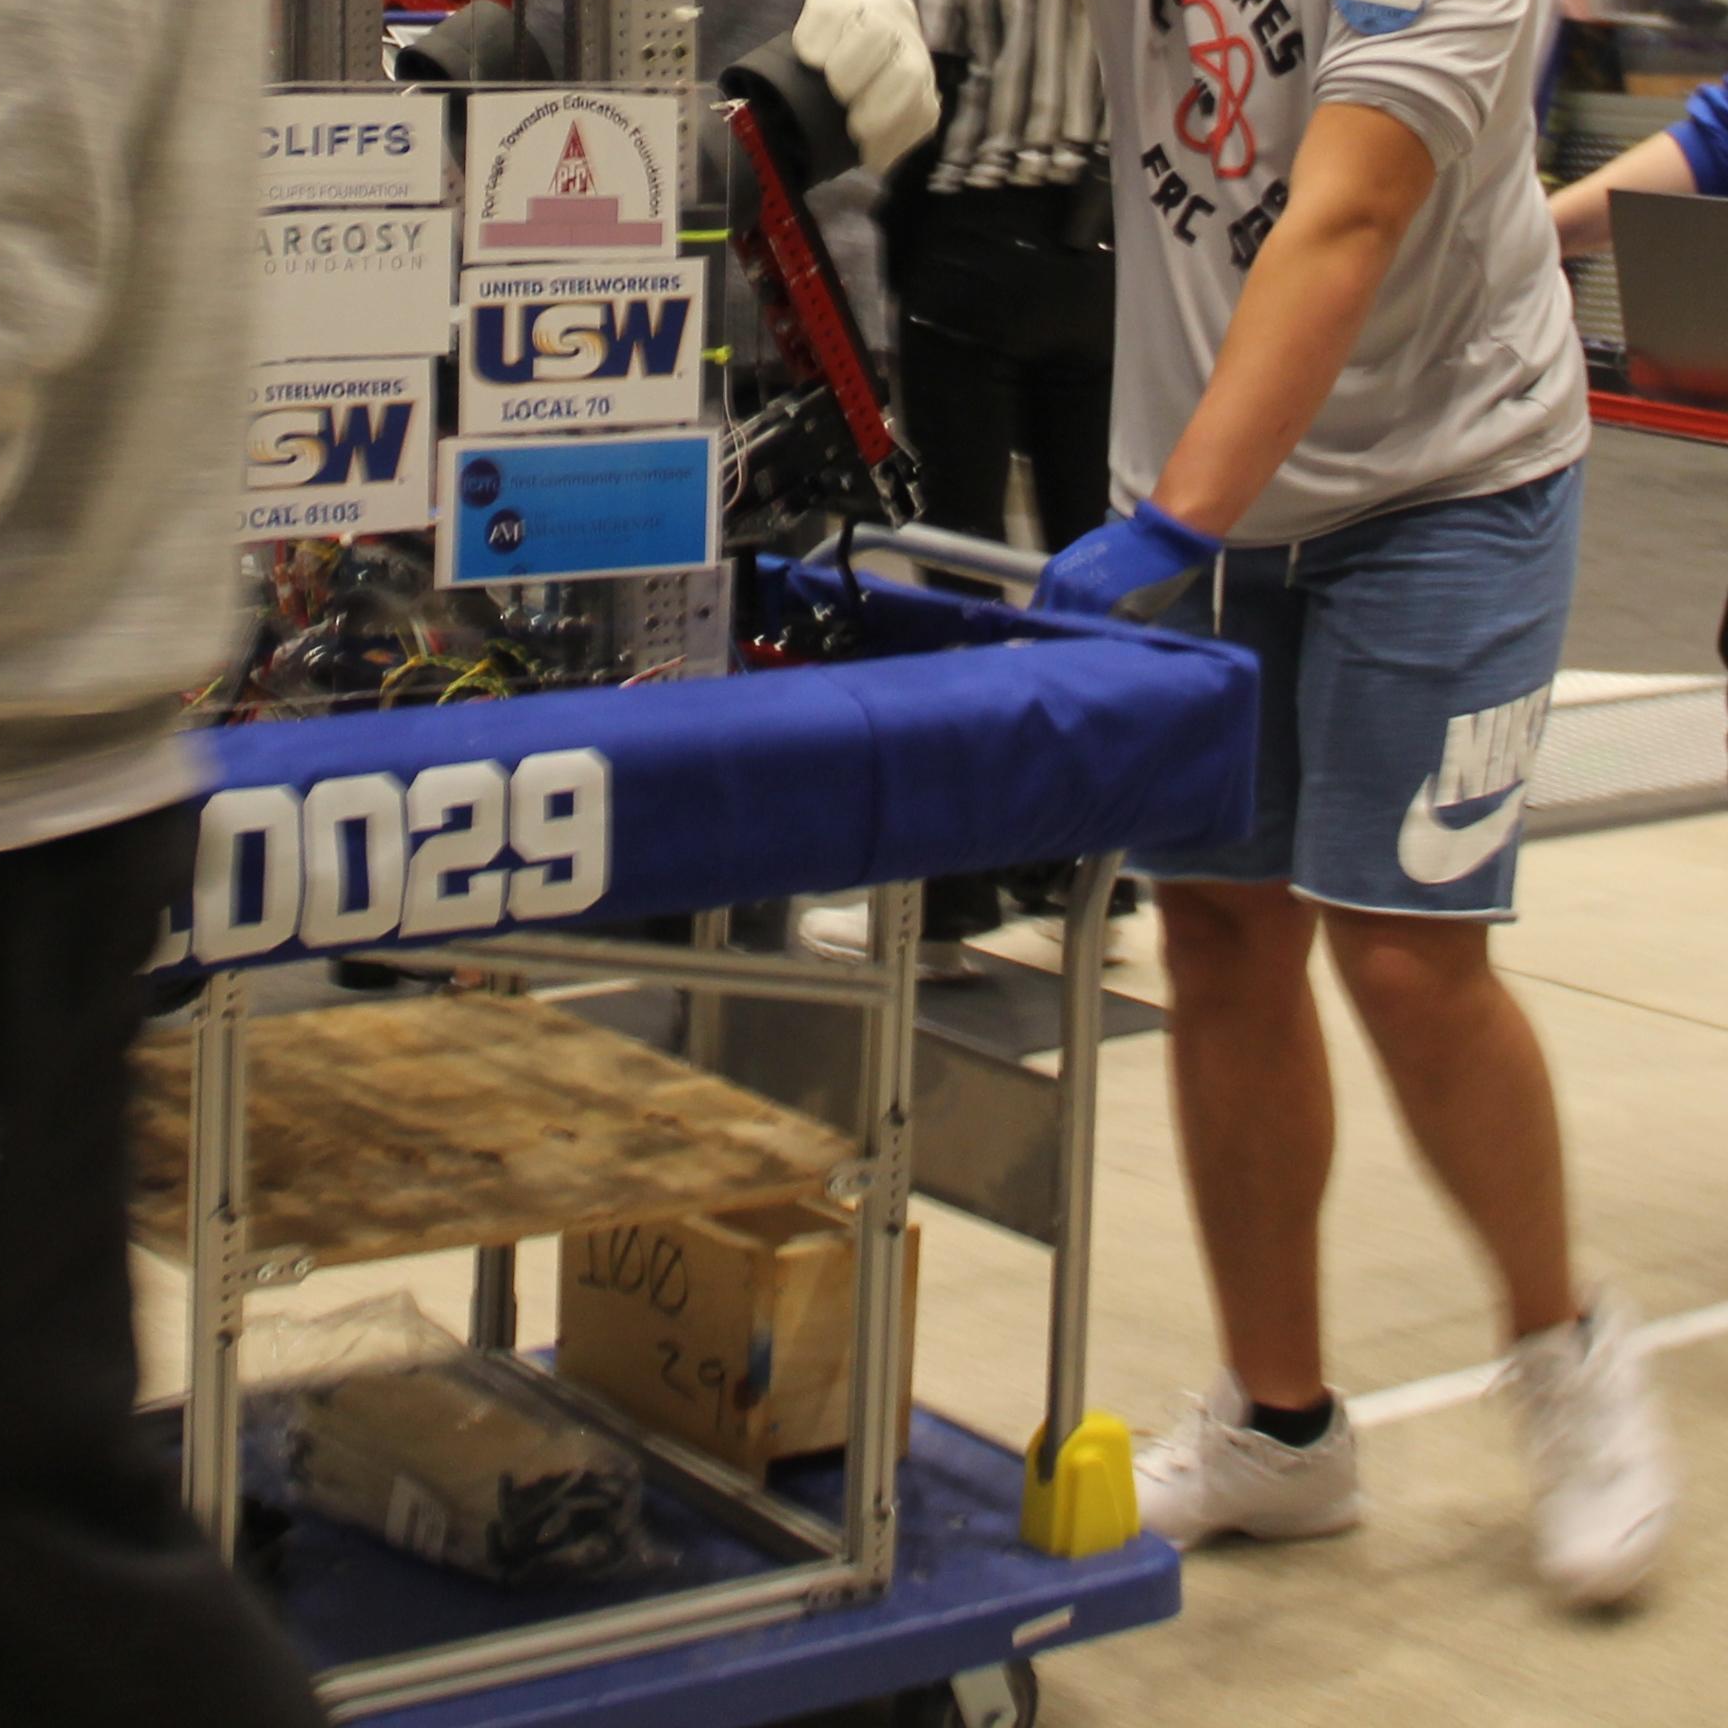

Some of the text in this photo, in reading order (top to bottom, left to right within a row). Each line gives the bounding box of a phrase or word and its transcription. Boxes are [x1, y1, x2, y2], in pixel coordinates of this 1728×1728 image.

[481, 155, 506, 220] Portage
[498, 100, 560, 151] Township
[562, 95, 630, 133] Education
[627, 126, 663, 218] Foundation
[319, 182, 409, 199] FOUNDATION
[1140, 143, 1217, 247] FRC
[263, 255, 425, 275] OUNDATION
[479, 274, 685, 298] UNITED STEELWORKERS
[473, 297, 691, 386] USW
[265, 379, 405, 402] STEELWORKERS
[500, 395, 612, 423] LOCAL 70
[148, 746, 613, 972] 0029
[655, 1338, 730, 1434] 29
